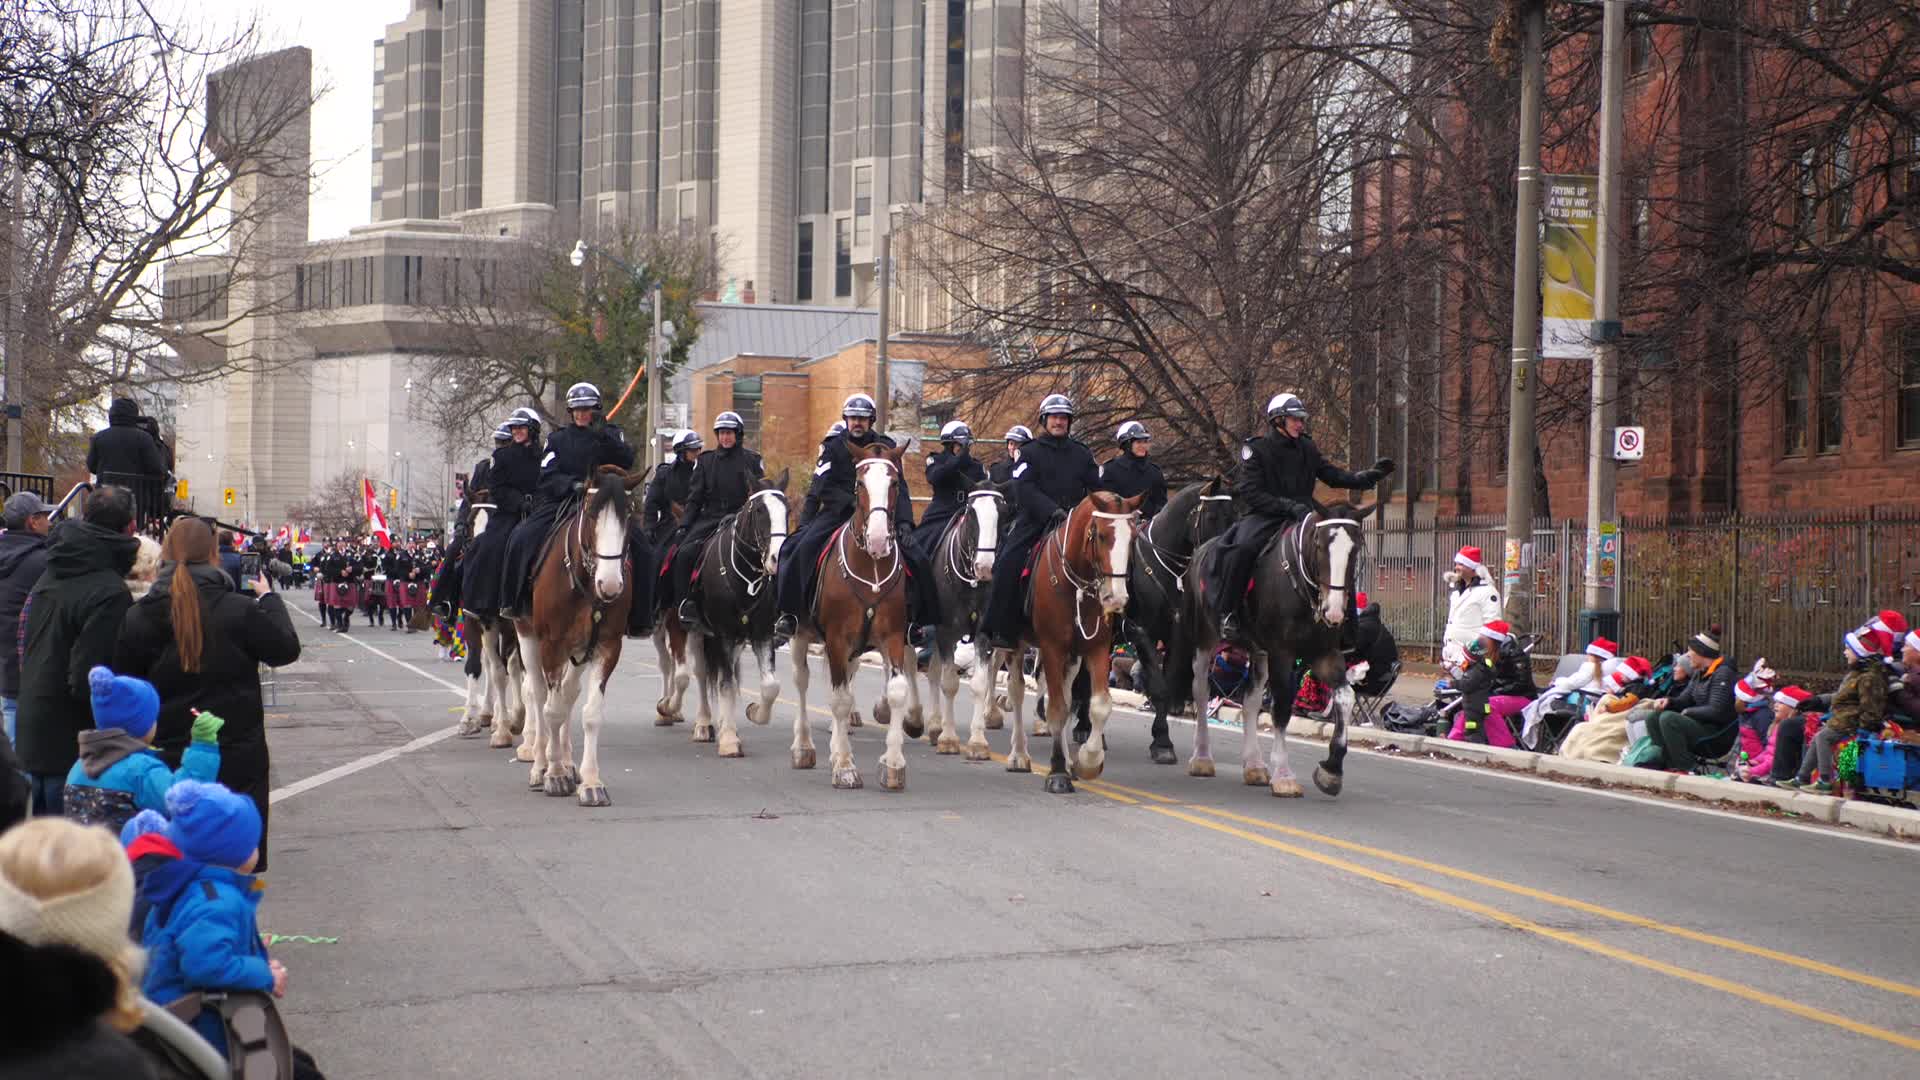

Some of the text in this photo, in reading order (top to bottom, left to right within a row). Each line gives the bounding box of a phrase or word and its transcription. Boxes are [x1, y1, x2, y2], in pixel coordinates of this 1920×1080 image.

[1551, 186, 1588, 196] FRYING UP
[1551, 197, 1589, 207] A NEW WAY
[1551, 208, 1593, 218] TO 3D PRINT
